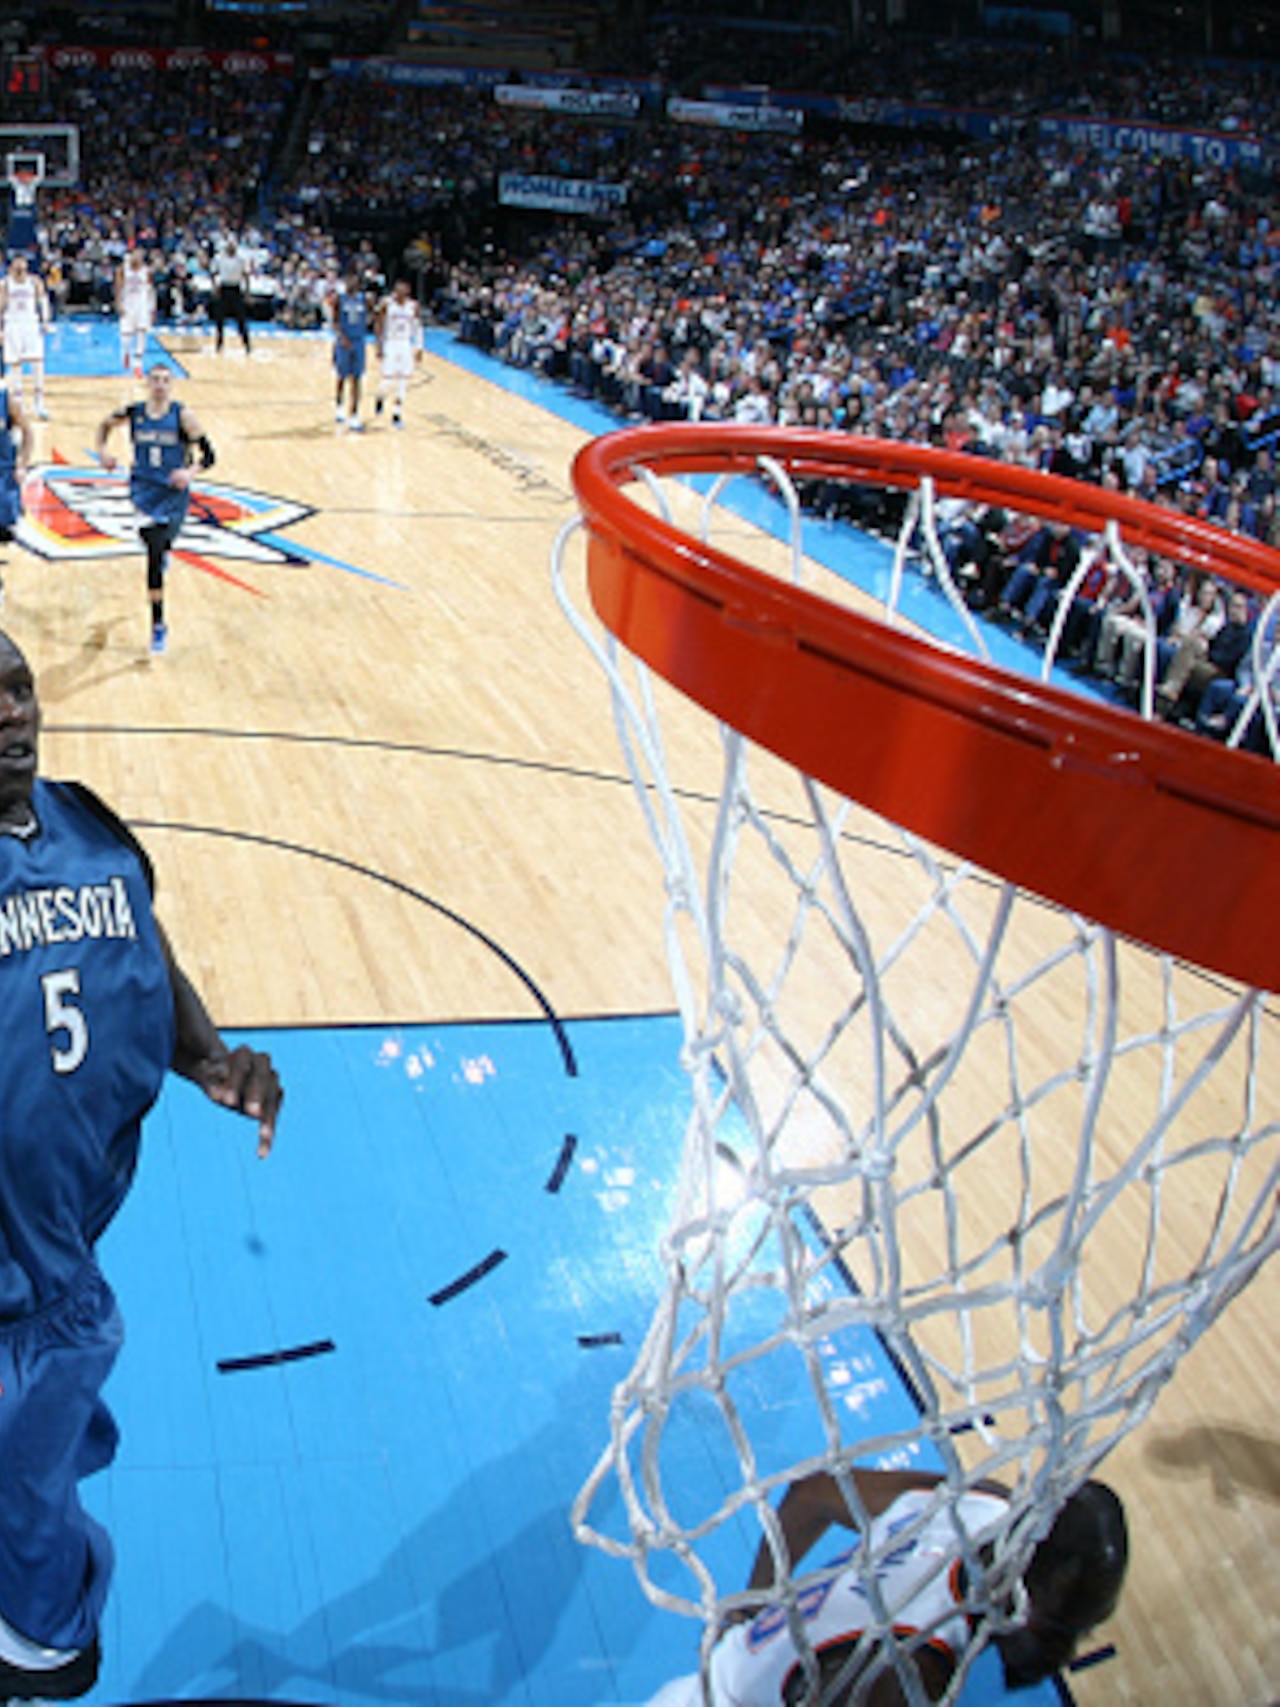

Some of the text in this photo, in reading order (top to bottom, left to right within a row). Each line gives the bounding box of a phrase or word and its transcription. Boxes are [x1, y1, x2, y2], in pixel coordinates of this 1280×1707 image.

[1068, 121, 1227, 167] WELCOME TO
[40, 967, 90, 1075] 5
